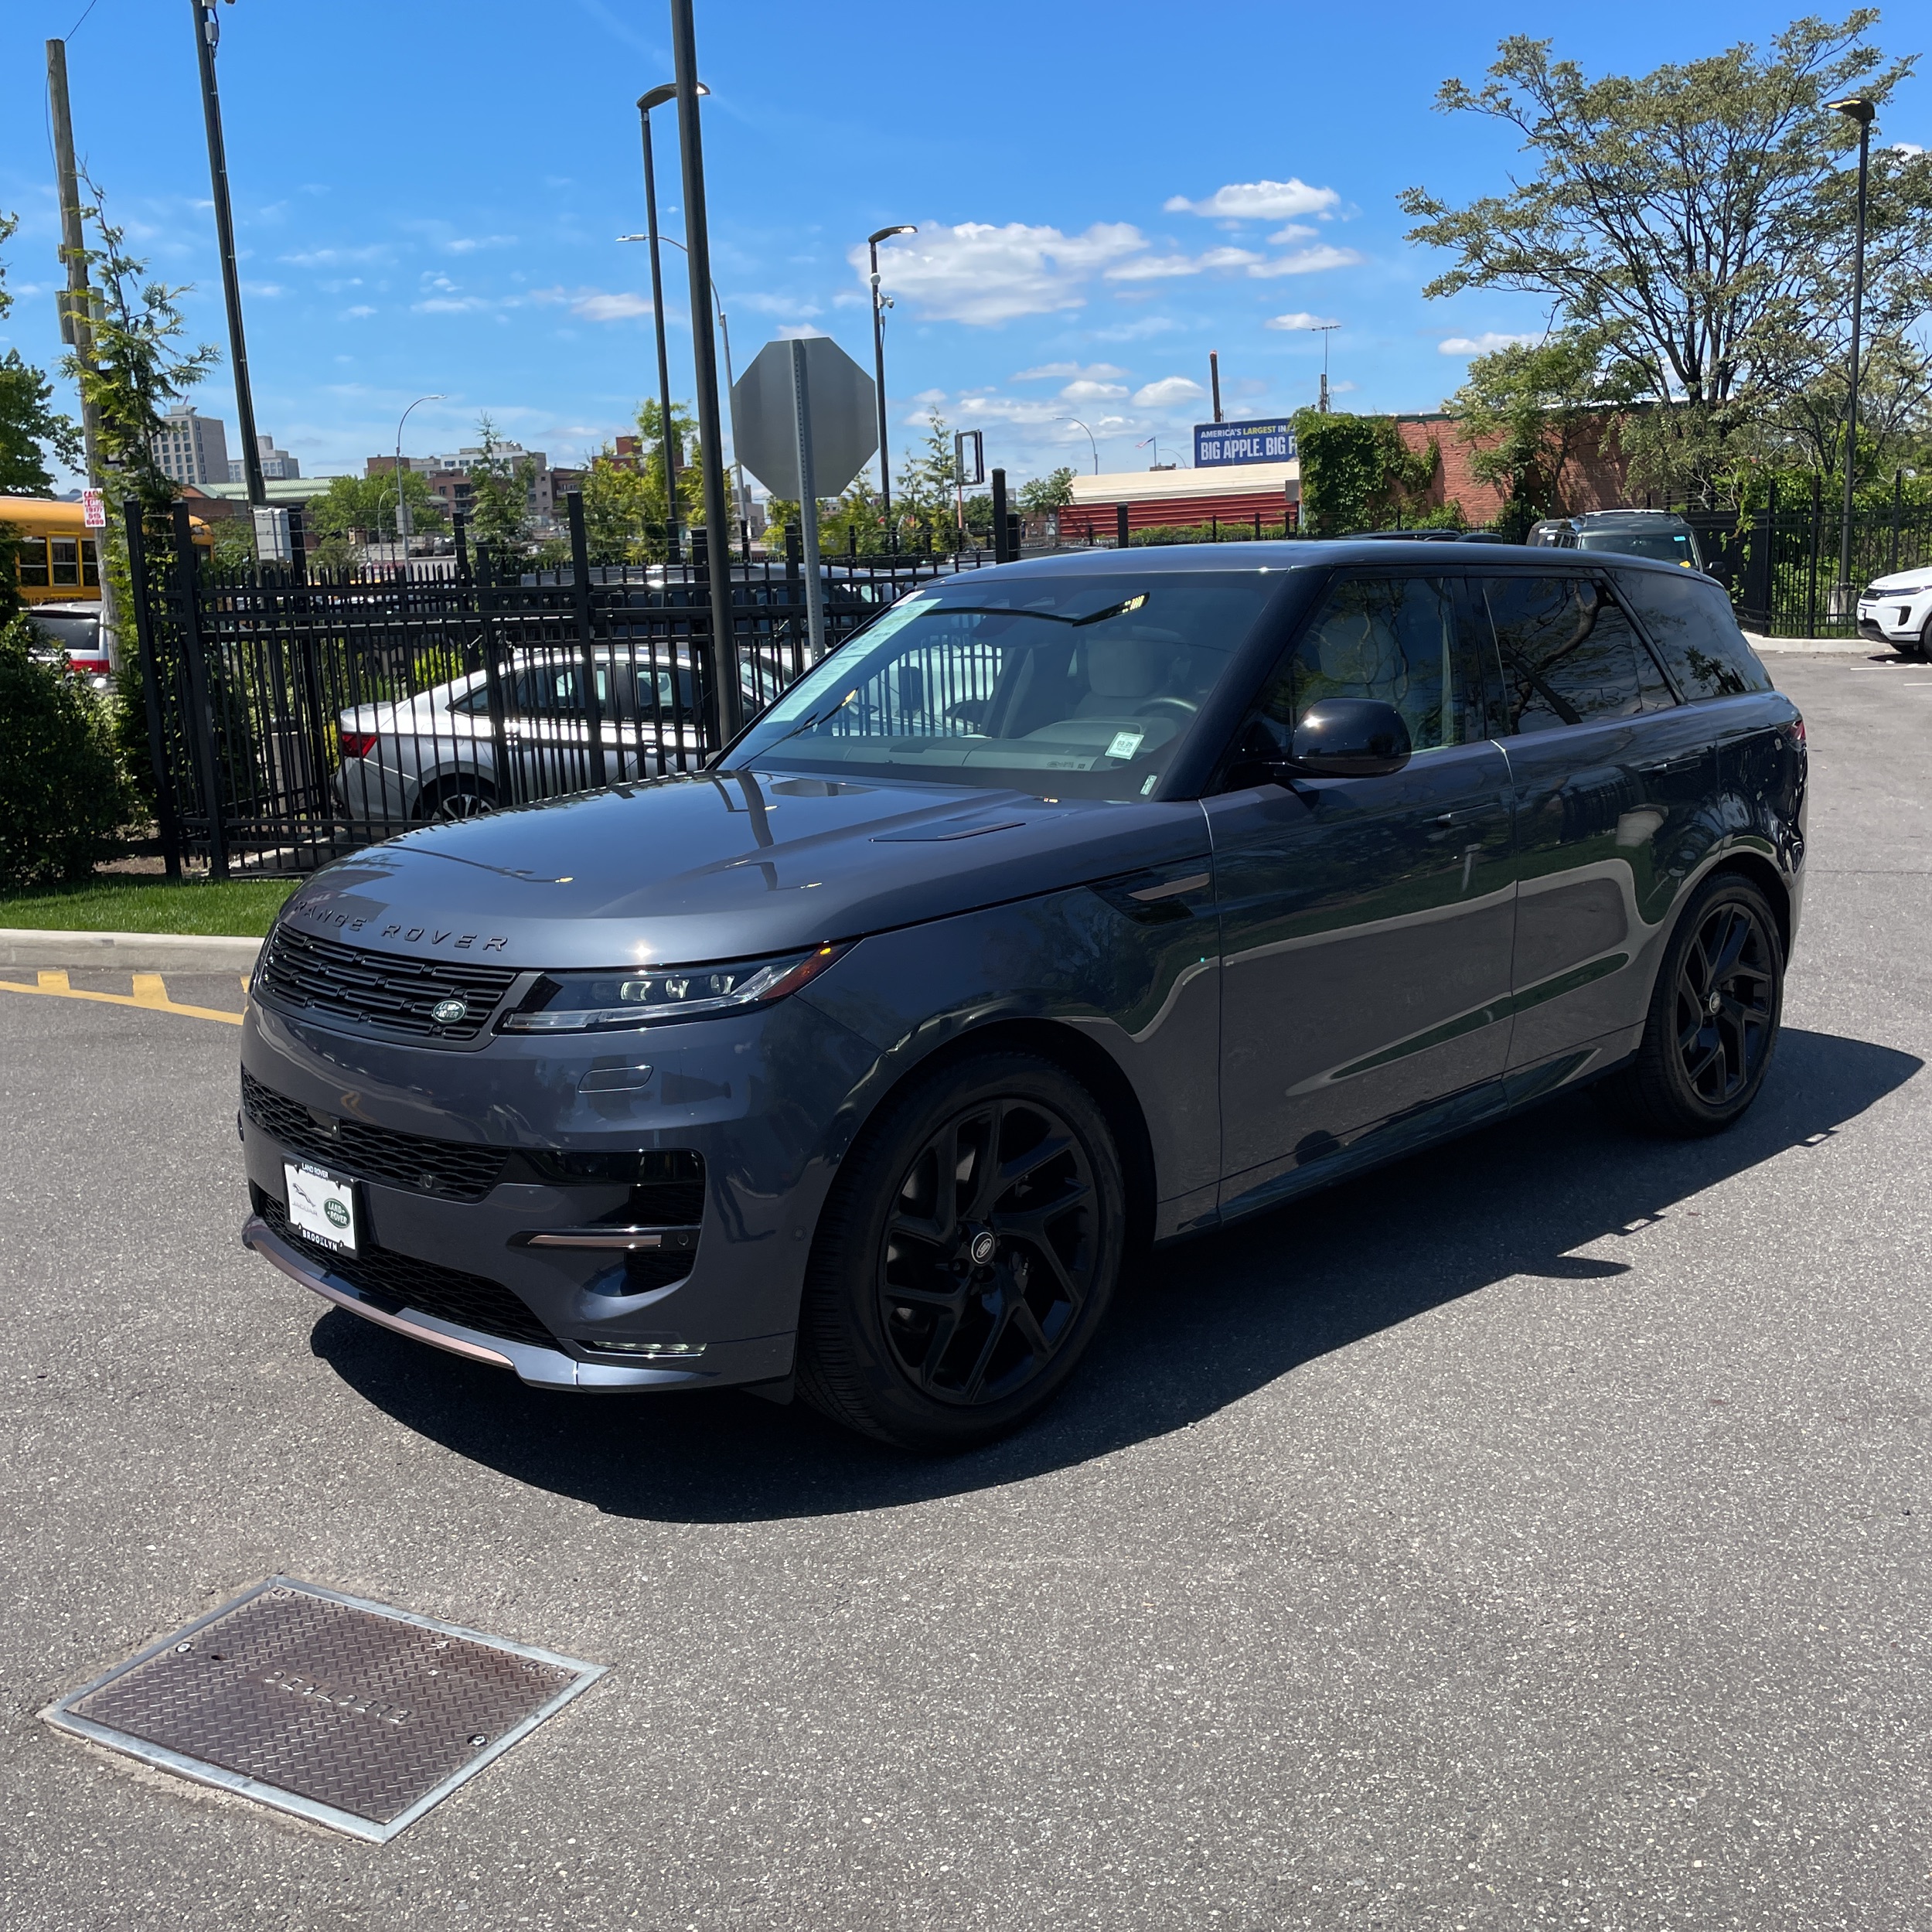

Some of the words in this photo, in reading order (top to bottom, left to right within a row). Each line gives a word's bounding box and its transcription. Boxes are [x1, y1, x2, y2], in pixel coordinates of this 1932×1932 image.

[1201, 428, 1242, 438] AMERICA'S
[1243, 425, 1276, 435] LARGEST
[1201, 441, 1221, 461] BIG
[1223, 438, 1263, 459] APPLE.
[1266, 436, 1286, 456] BIG
[294, 901, 367, 932] RANGE
[381, 925, 508, 952] ROVER
[302, 1162, 314, 1174] LAND
[314, 1167, 329, 1178] ROVER
[291, 1201, 318, 1216] JAGUAR
[328, 1201, 342, 1215] LAND
[329, 1211, 347, 1225] ROVER
[302, 1229, 338, 1252] BROOKLYN
[264, 1671, 413, 1724] ELECTRIC
